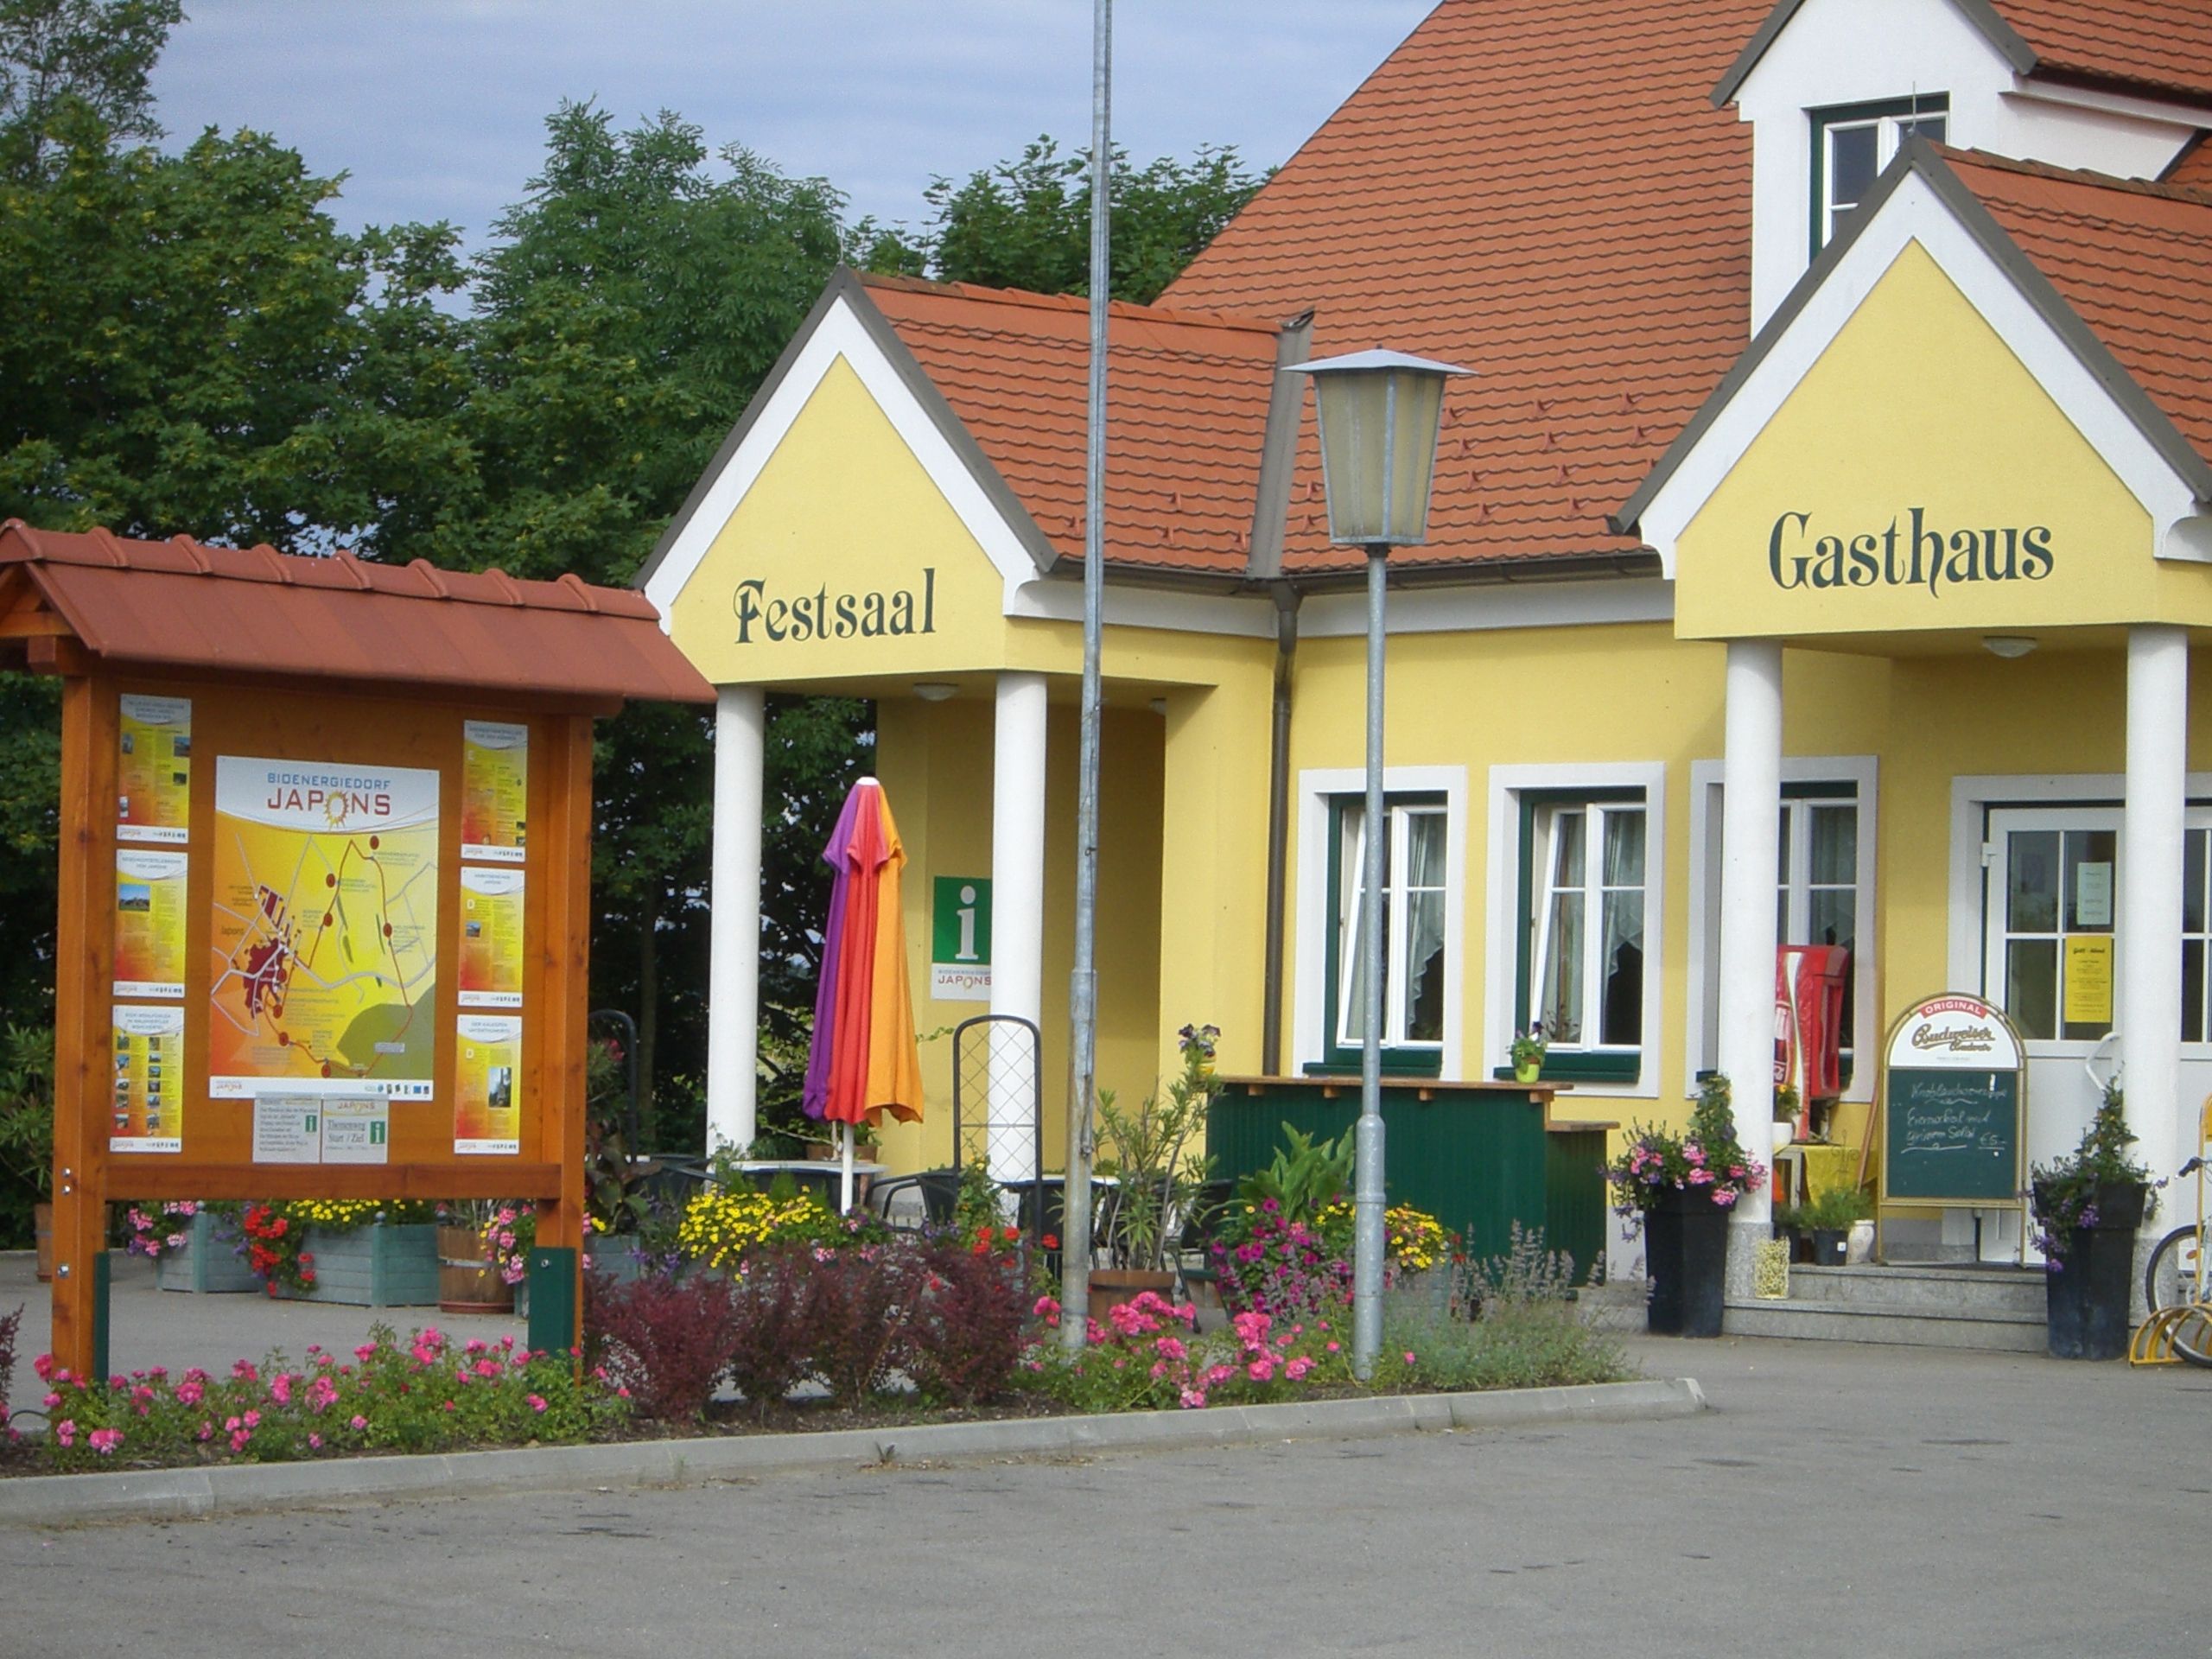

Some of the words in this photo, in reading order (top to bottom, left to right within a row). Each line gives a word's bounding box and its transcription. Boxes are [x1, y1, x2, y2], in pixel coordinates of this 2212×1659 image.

[1769, 507, 2054, 599] Gasthaus
[733, 568, 936, 644] Festsaal
[267, 772, 391, 790] BIOENERGIEDORF
[267, 787, 391, 823] JAPONS
[955, 885, 979, 960] i
[938, 976, 992, 988] JAPONS
[1924, 1001, 1981, 1014] ORIGINAL
